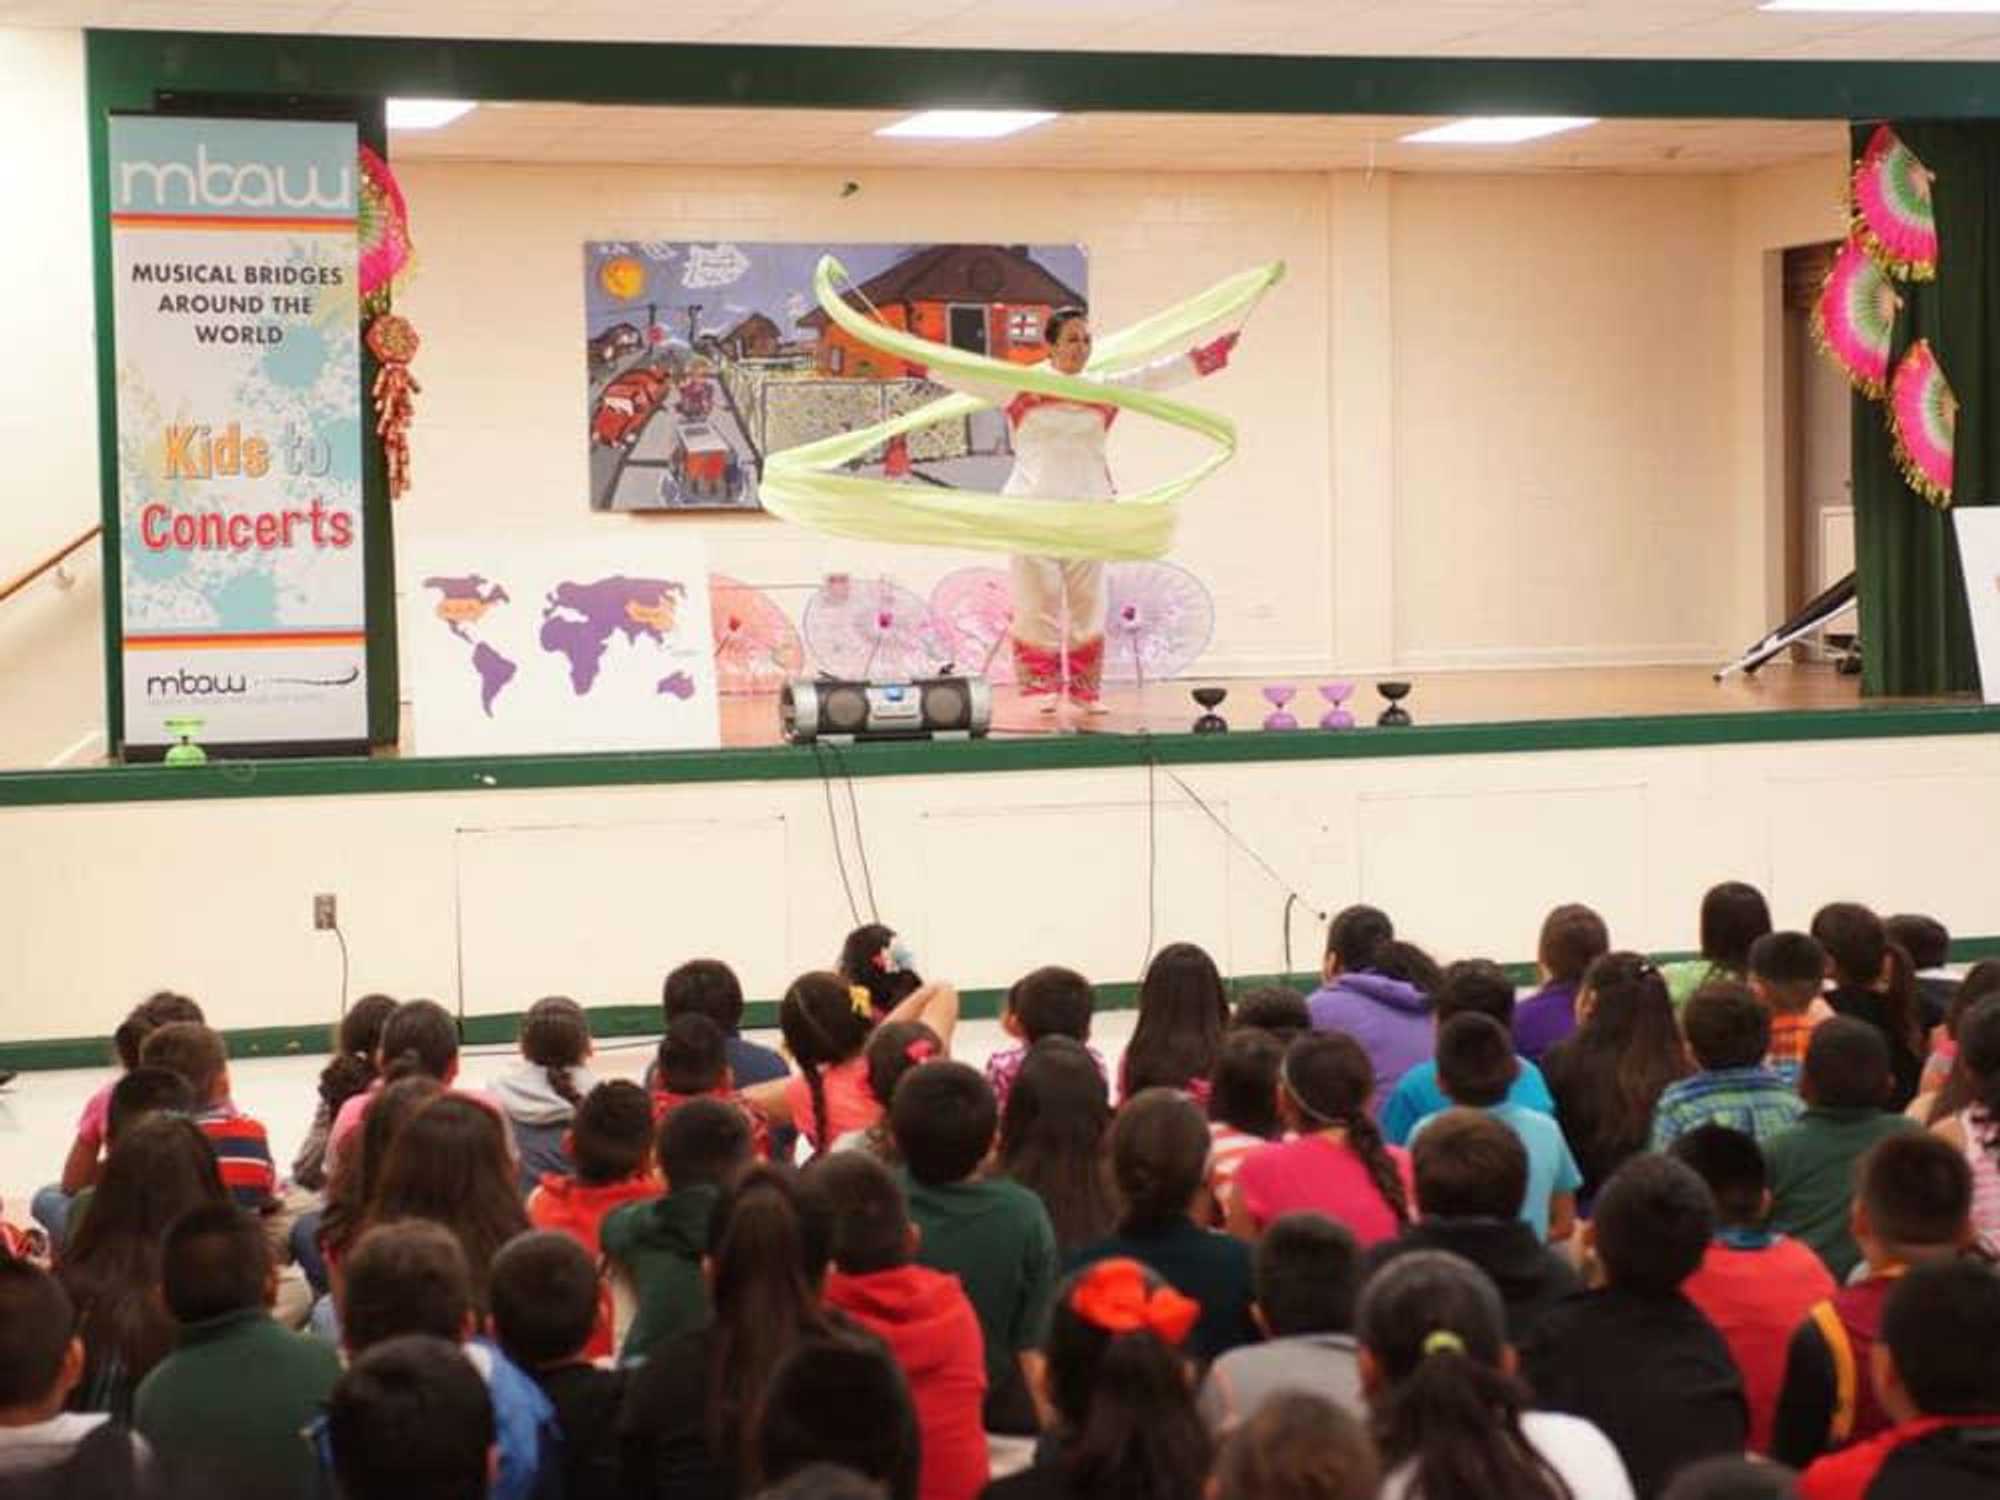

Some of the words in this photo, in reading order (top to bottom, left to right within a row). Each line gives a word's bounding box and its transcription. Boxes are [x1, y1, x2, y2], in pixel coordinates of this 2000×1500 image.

[119, 143, 350, 207] mbaw
[131, 262, 238, 285] MUSICAL
[243, 264, 343, 286] BRIDGES
[157, 294, 264, 315] AROUND
[271, 296, 313, 315] THE
[195, 325, 283, 345] WORLD
[162, 422, 271, 480] Kids
[282, 421, 332, 478] to
[141, 498, 354, 552] Concerts
[146, 668, 246, 696] mbaw
